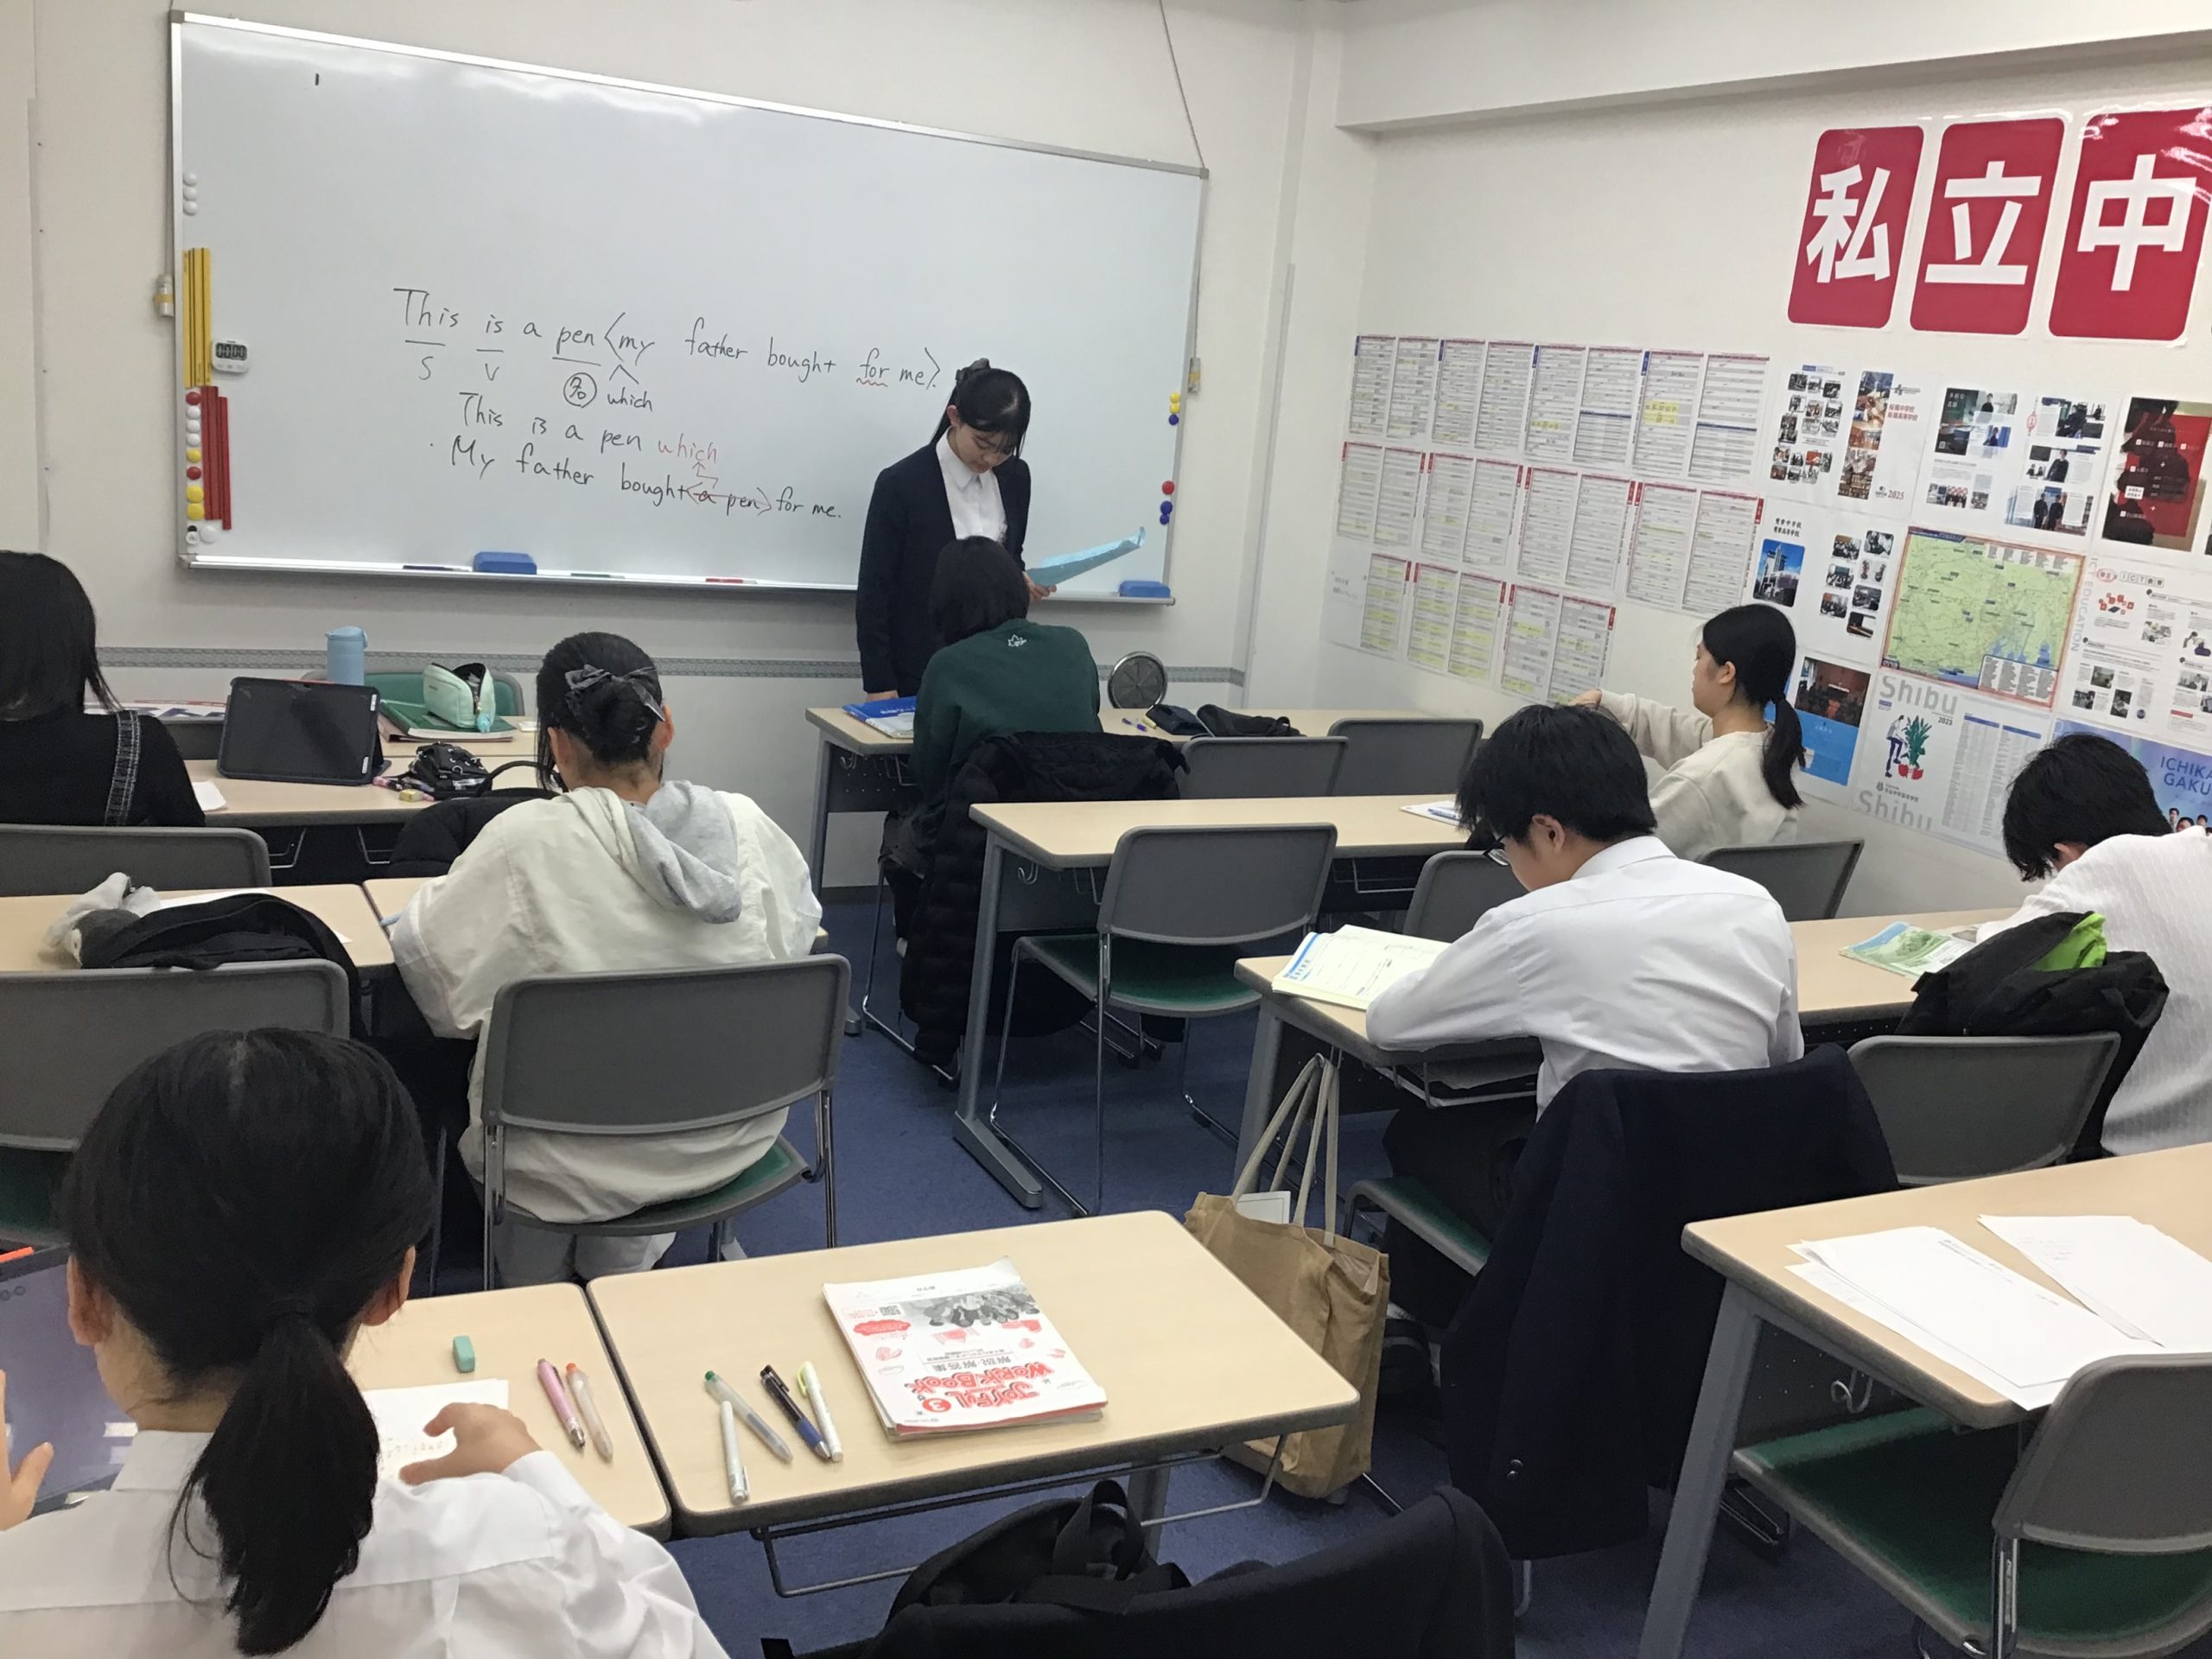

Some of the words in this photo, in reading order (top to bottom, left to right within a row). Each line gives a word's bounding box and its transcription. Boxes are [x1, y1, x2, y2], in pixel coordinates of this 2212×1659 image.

[393, 288, 459, 327] This
[486, 315, 504, 334] is
[523, 321, 543, 338] a
[556, 327, 594, 355] pen
[685, 317, 748, 359] father
[768, 337, 836, 383] bought
[860, 347, 890, 378] for
[418, 356, 434, 380] S
[459, 391, 504, 427] This
[532, 417, 547, 435] is
[565, 424, 584, 441] a
[601, 429, 642, 454] pen
[658, 433, 717, 464] which
[607, 387, 653, 411] which
[451, 435, 495, 480] My
[516, 442, 594, 485] father
[621, 462, 687, 507] bought
[776, 486, 804, 512] for
[2070, 581, 2094, 652] EDUCATION
[1879, 675, 1958, 715] Shibu
